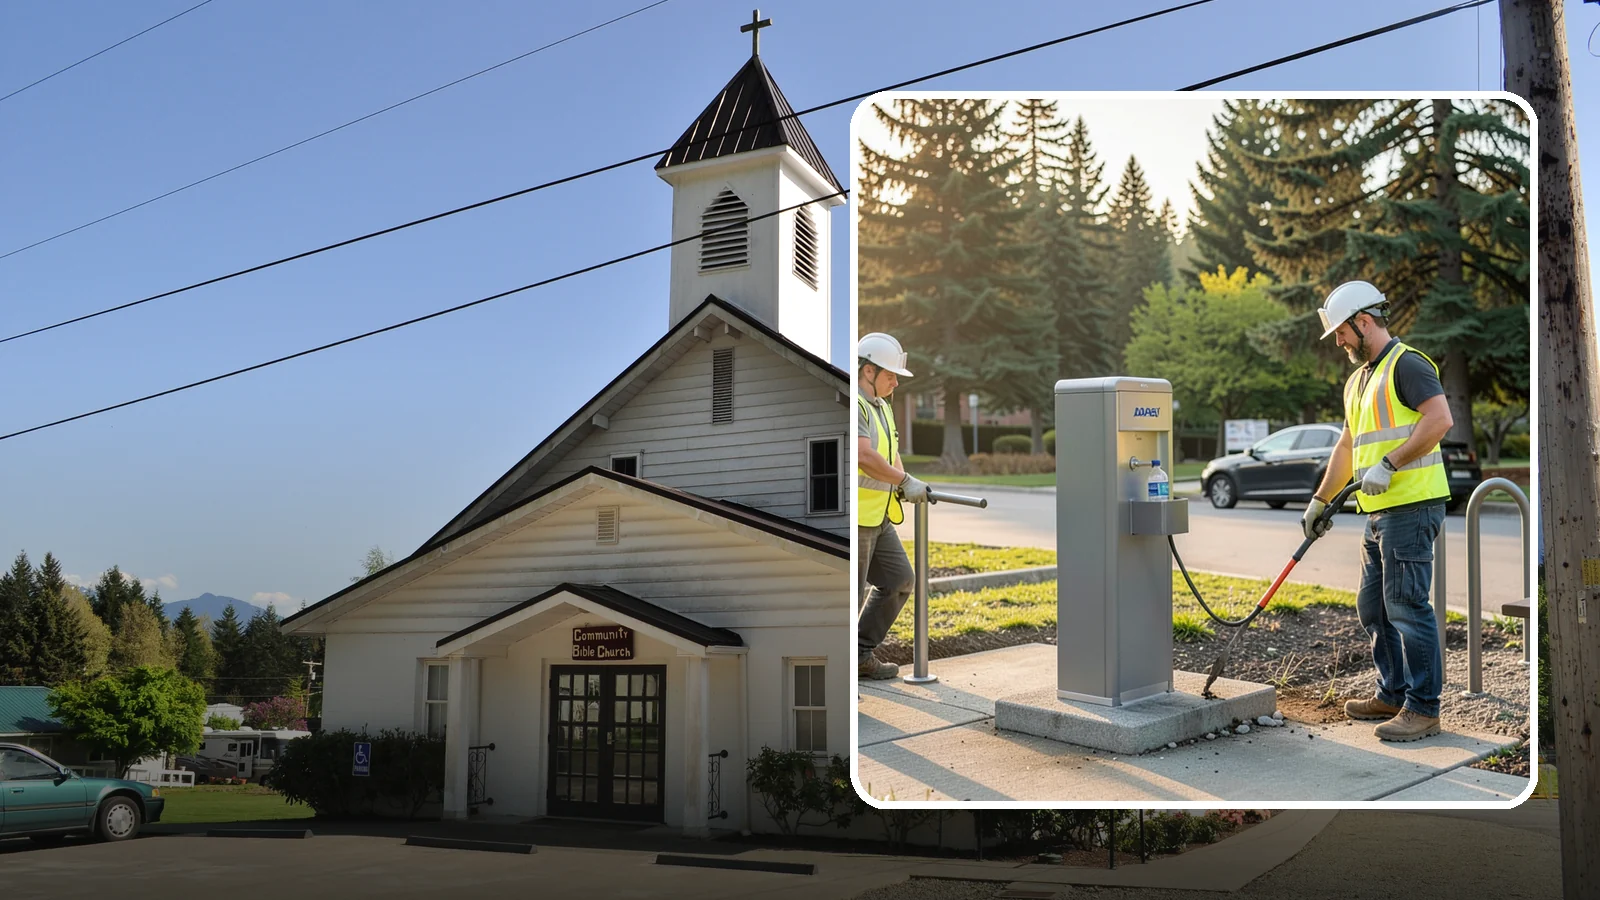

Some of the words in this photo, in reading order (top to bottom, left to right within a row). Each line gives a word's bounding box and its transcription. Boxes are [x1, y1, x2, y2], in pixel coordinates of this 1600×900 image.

[574, 627, 628, 641] Community
[573, 644, 595, 657] Bible
[597, 645, 630, 657] Church
